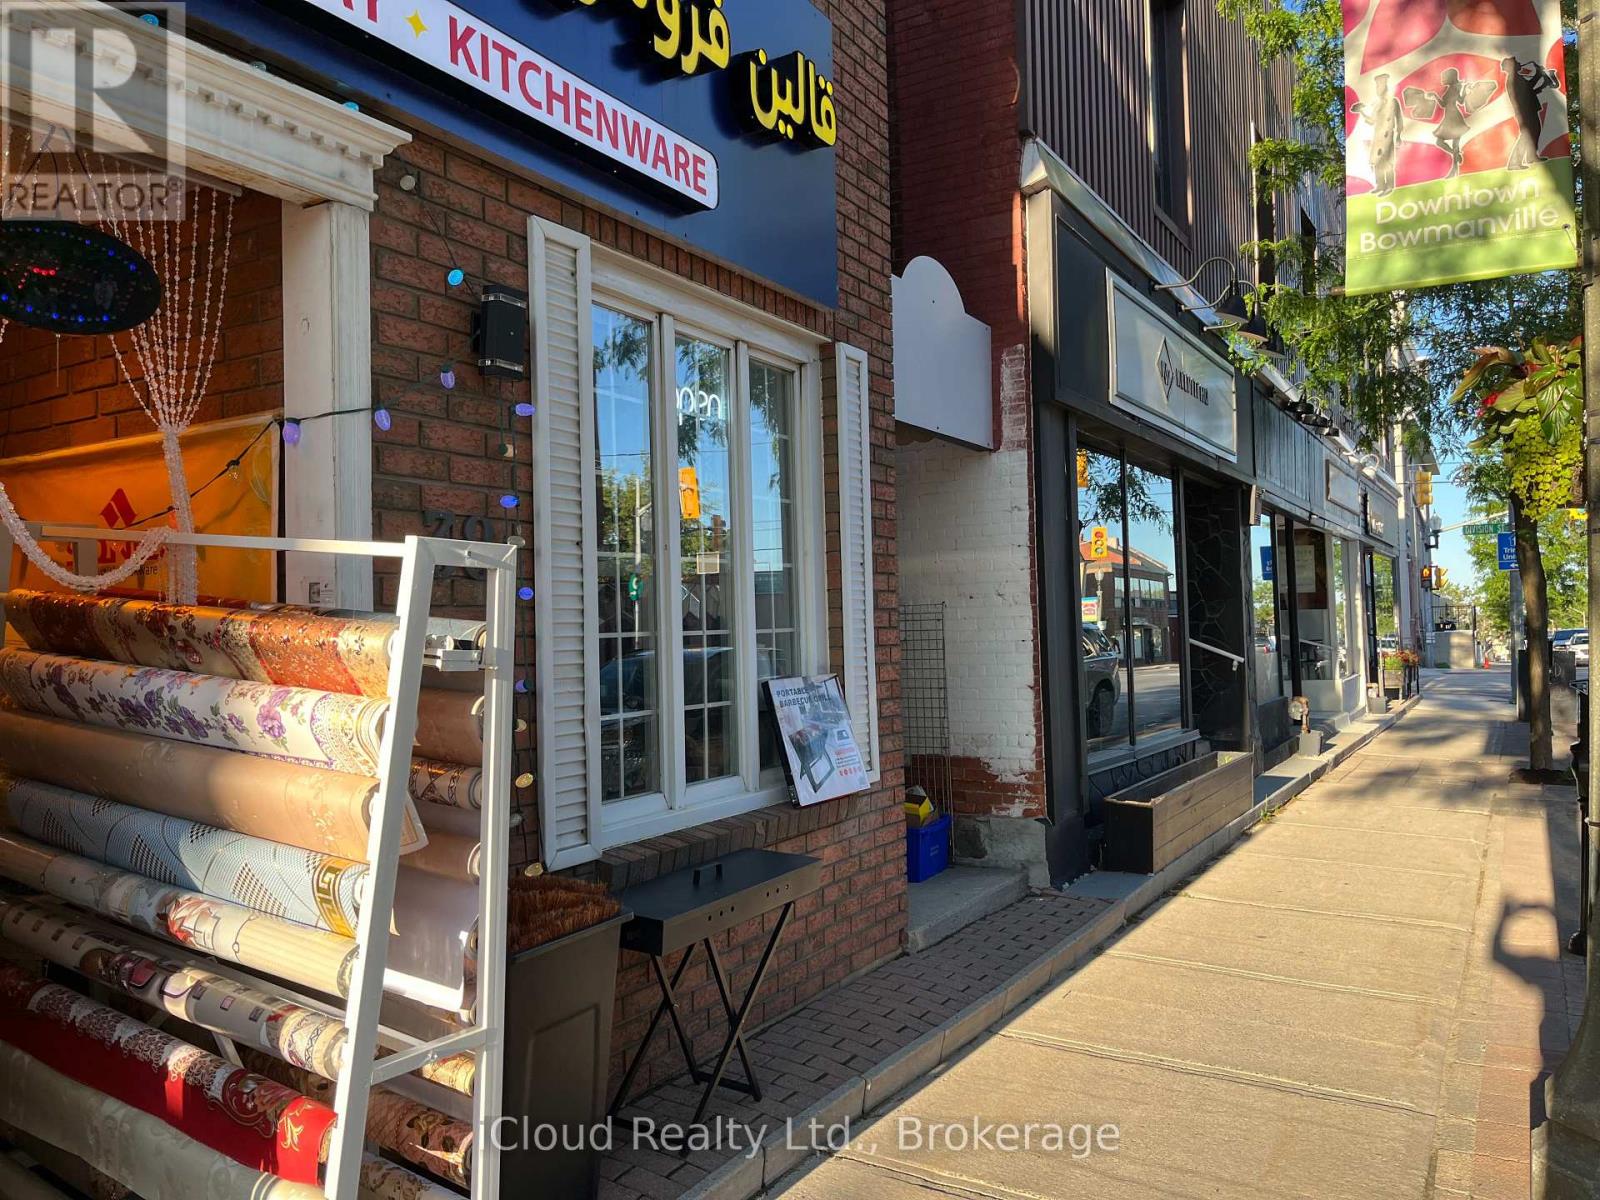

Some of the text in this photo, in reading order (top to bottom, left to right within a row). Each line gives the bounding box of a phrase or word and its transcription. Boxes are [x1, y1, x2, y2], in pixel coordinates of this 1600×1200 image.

[448, 15, 707, 196] KITCHENWARE
[1375, 176, 1540, 225] Downtown
[1360, 203, 1559, 254] Bowmanville
[776, 687, 810, 698] PORTABLE
